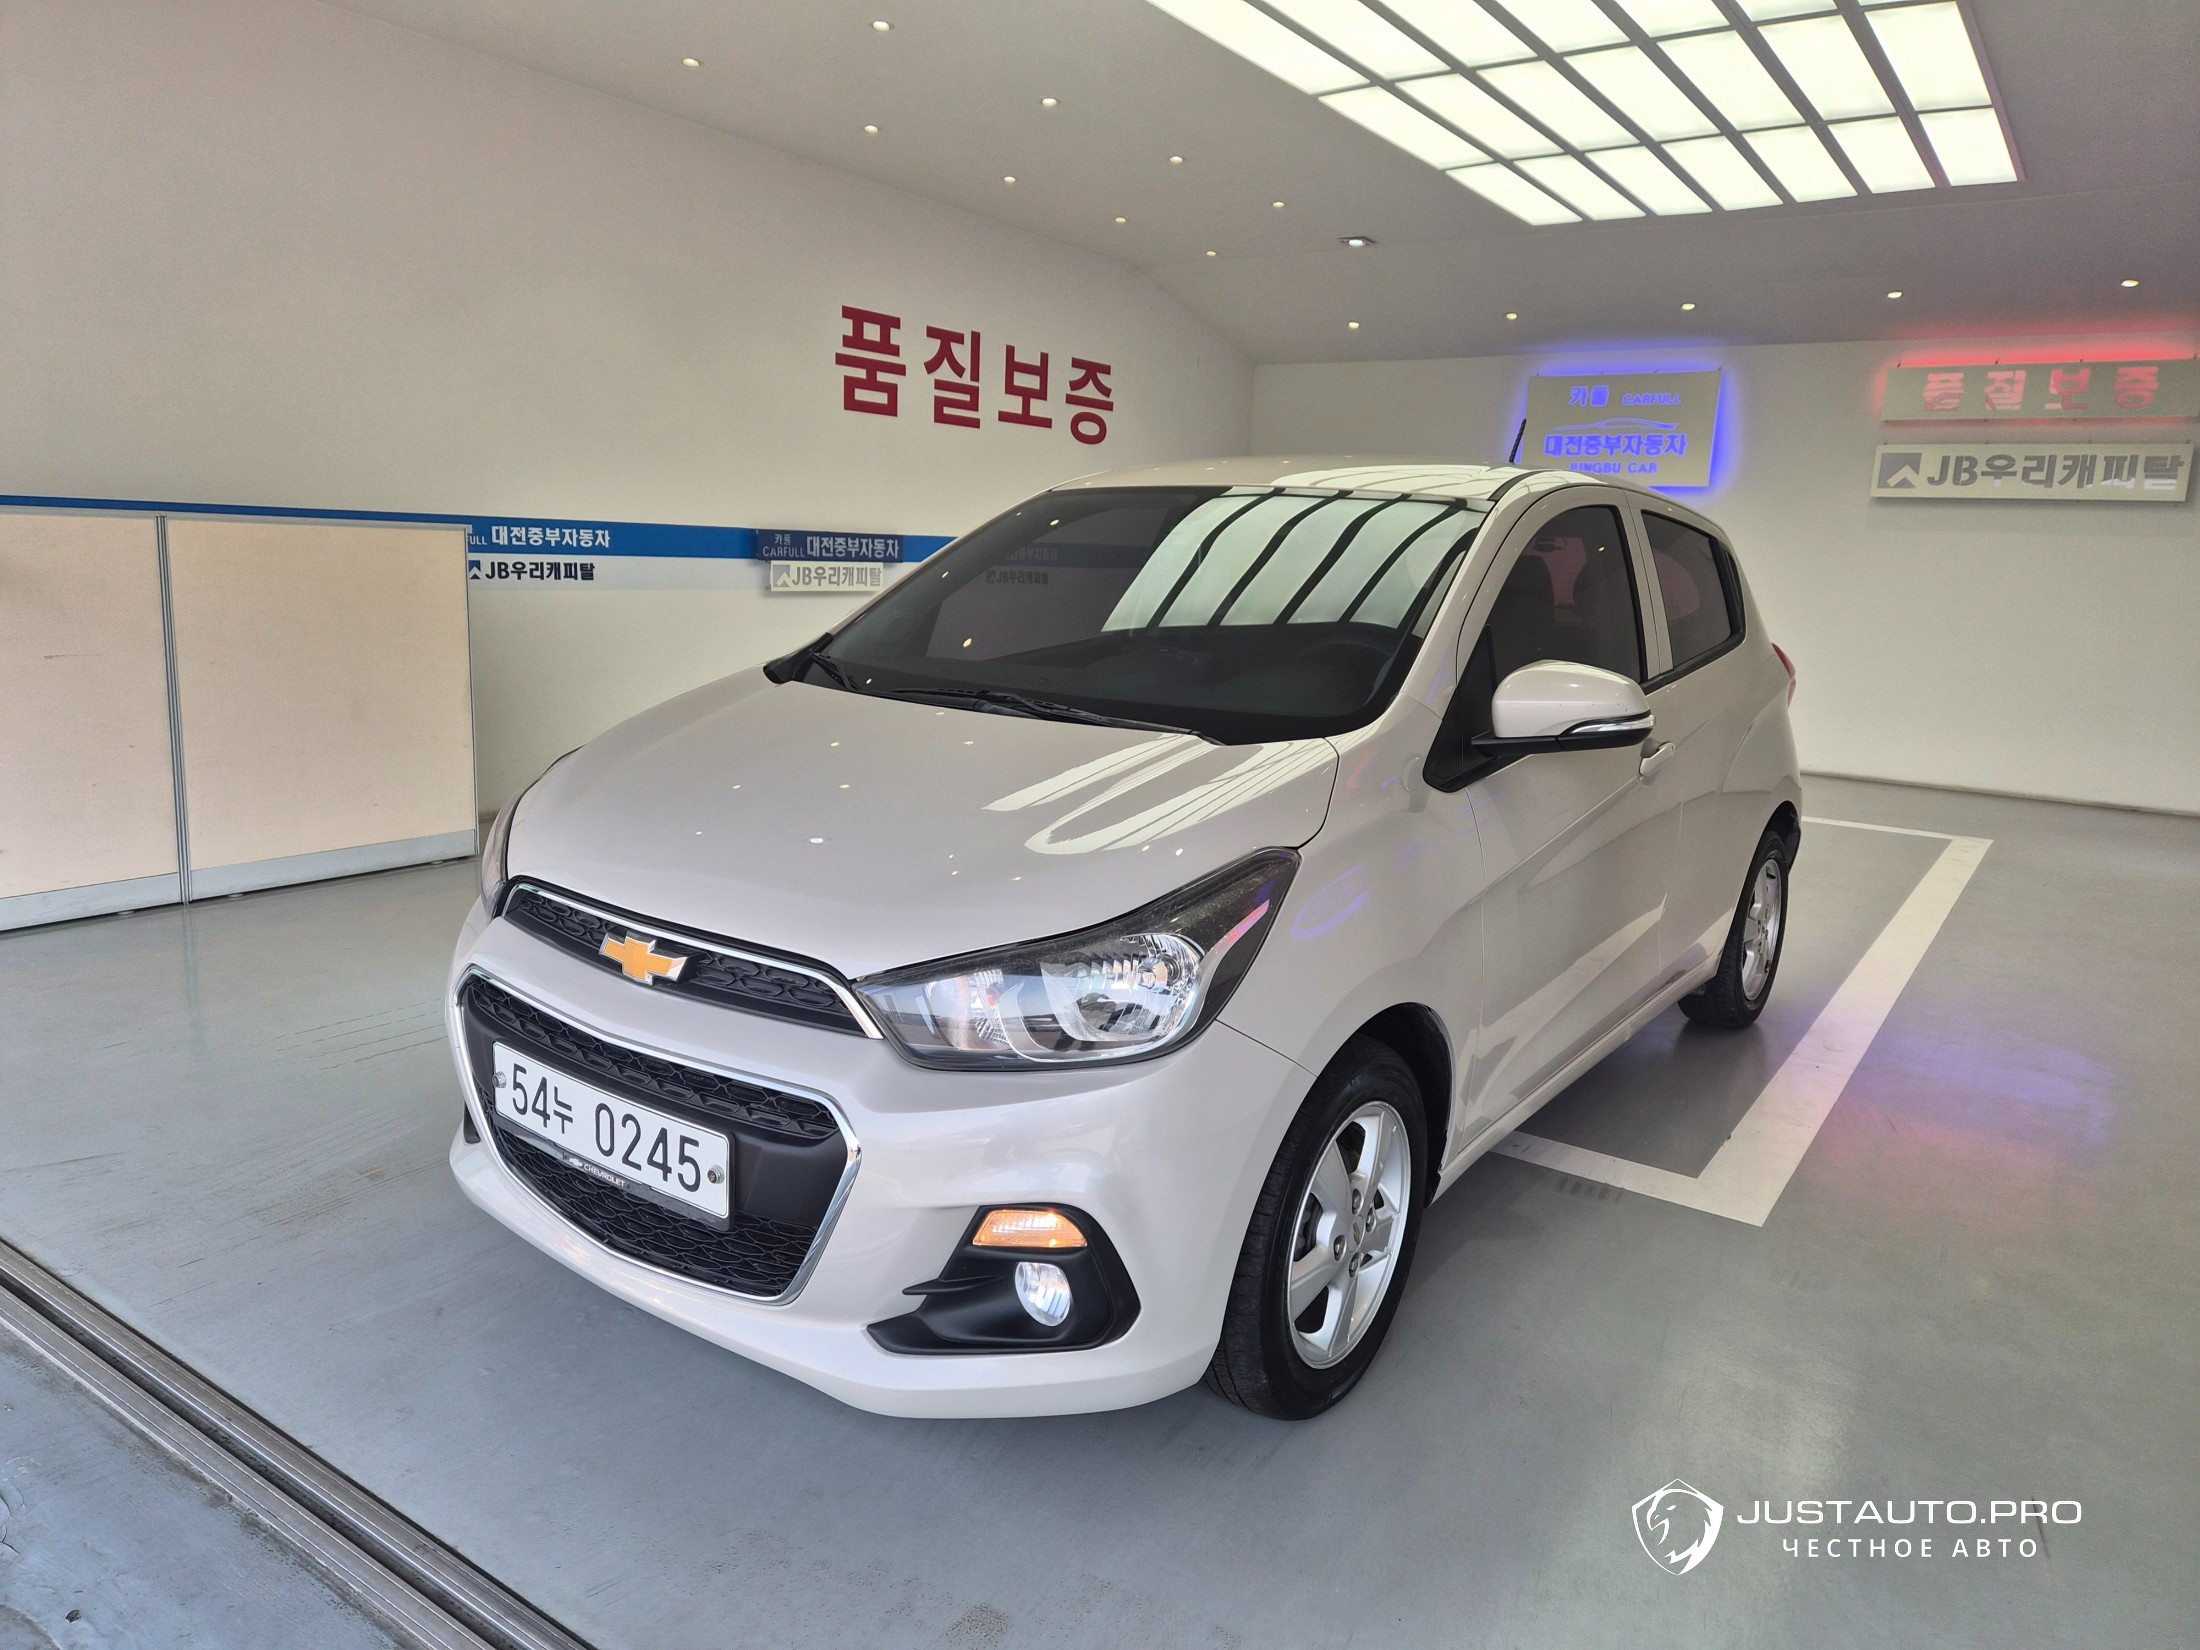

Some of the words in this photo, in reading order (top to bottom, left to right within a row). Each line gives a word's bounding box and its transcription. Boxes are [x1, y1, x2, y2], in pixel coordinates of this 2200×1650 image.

[835, 305, 1114, 444] 품질보증
[1621, 391, 1681, 406] CARFULL
[1627, 461, 1659, 474] CAR
[1926, 454, 2185, 490] JB우리캐피탈
[491, 525, 611, 548] 대전중부자동차
[762, 545, 805, 558] CARFULL
[806, 535, 900, 559] 대전중부자동차
[485, 561, 596, 581] JB우리캐피탈
[791, 566, 882, 587] JB우리캐피탈
[512, 1063, 574, 1135] 54누
[595, 1102, 701, 1193] 0245
[583, 1162, 626, 1187] CHEVROLET
